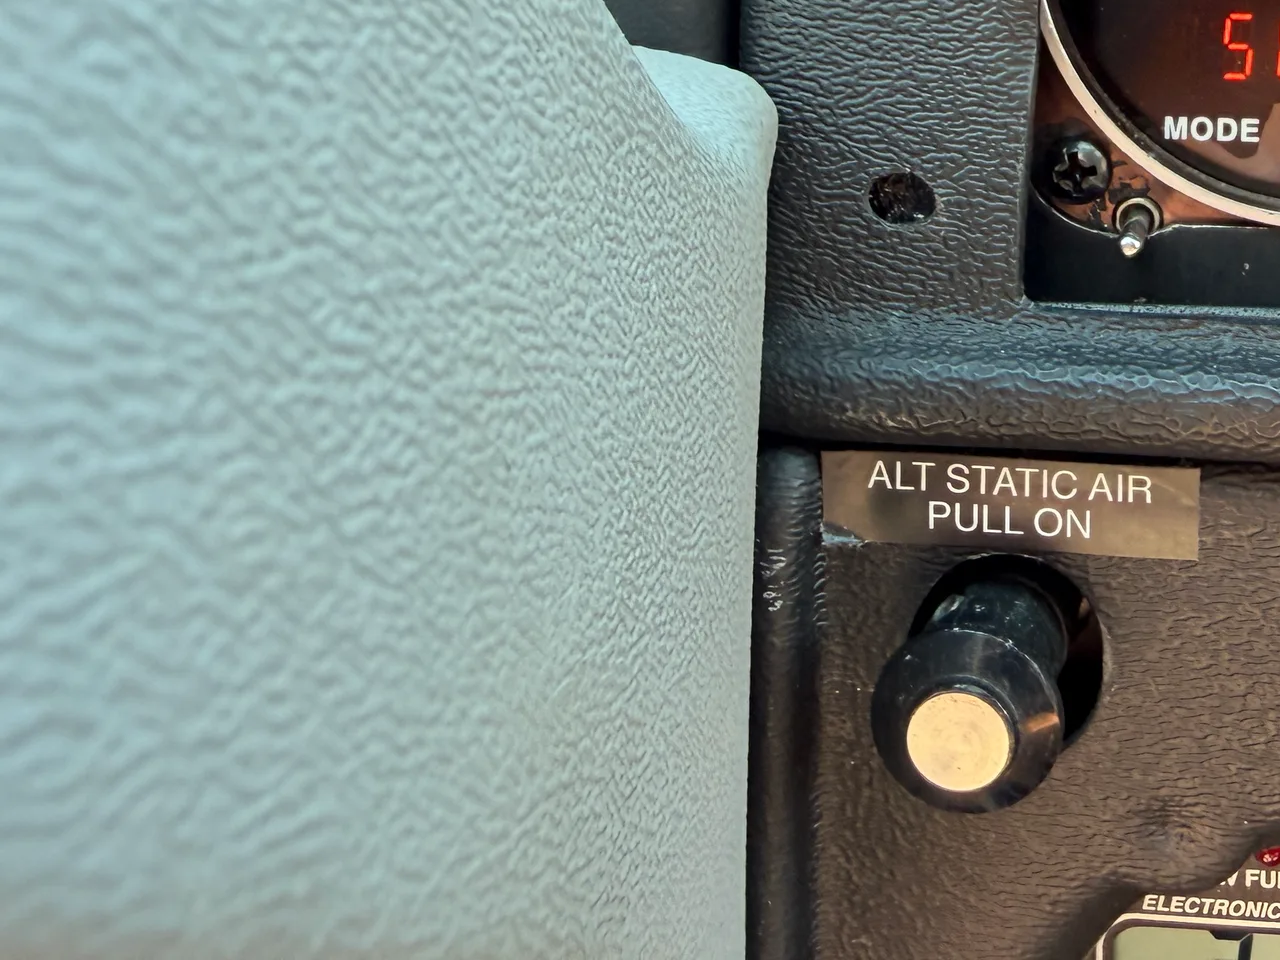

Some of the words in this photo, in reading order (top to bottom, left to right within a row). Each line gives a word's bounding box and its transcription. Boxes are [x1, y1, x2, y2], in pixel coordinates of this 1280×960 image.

[1164, 116, 1260, 143] MODE
[867, 460, 935, 491] ALT
[946, 463, 1077, 500] STATIC
[1088, 473, 1152, 504] AIR
[928, 501, 1024, 535] PULL
[1033, 508, 1091, 539] ON
